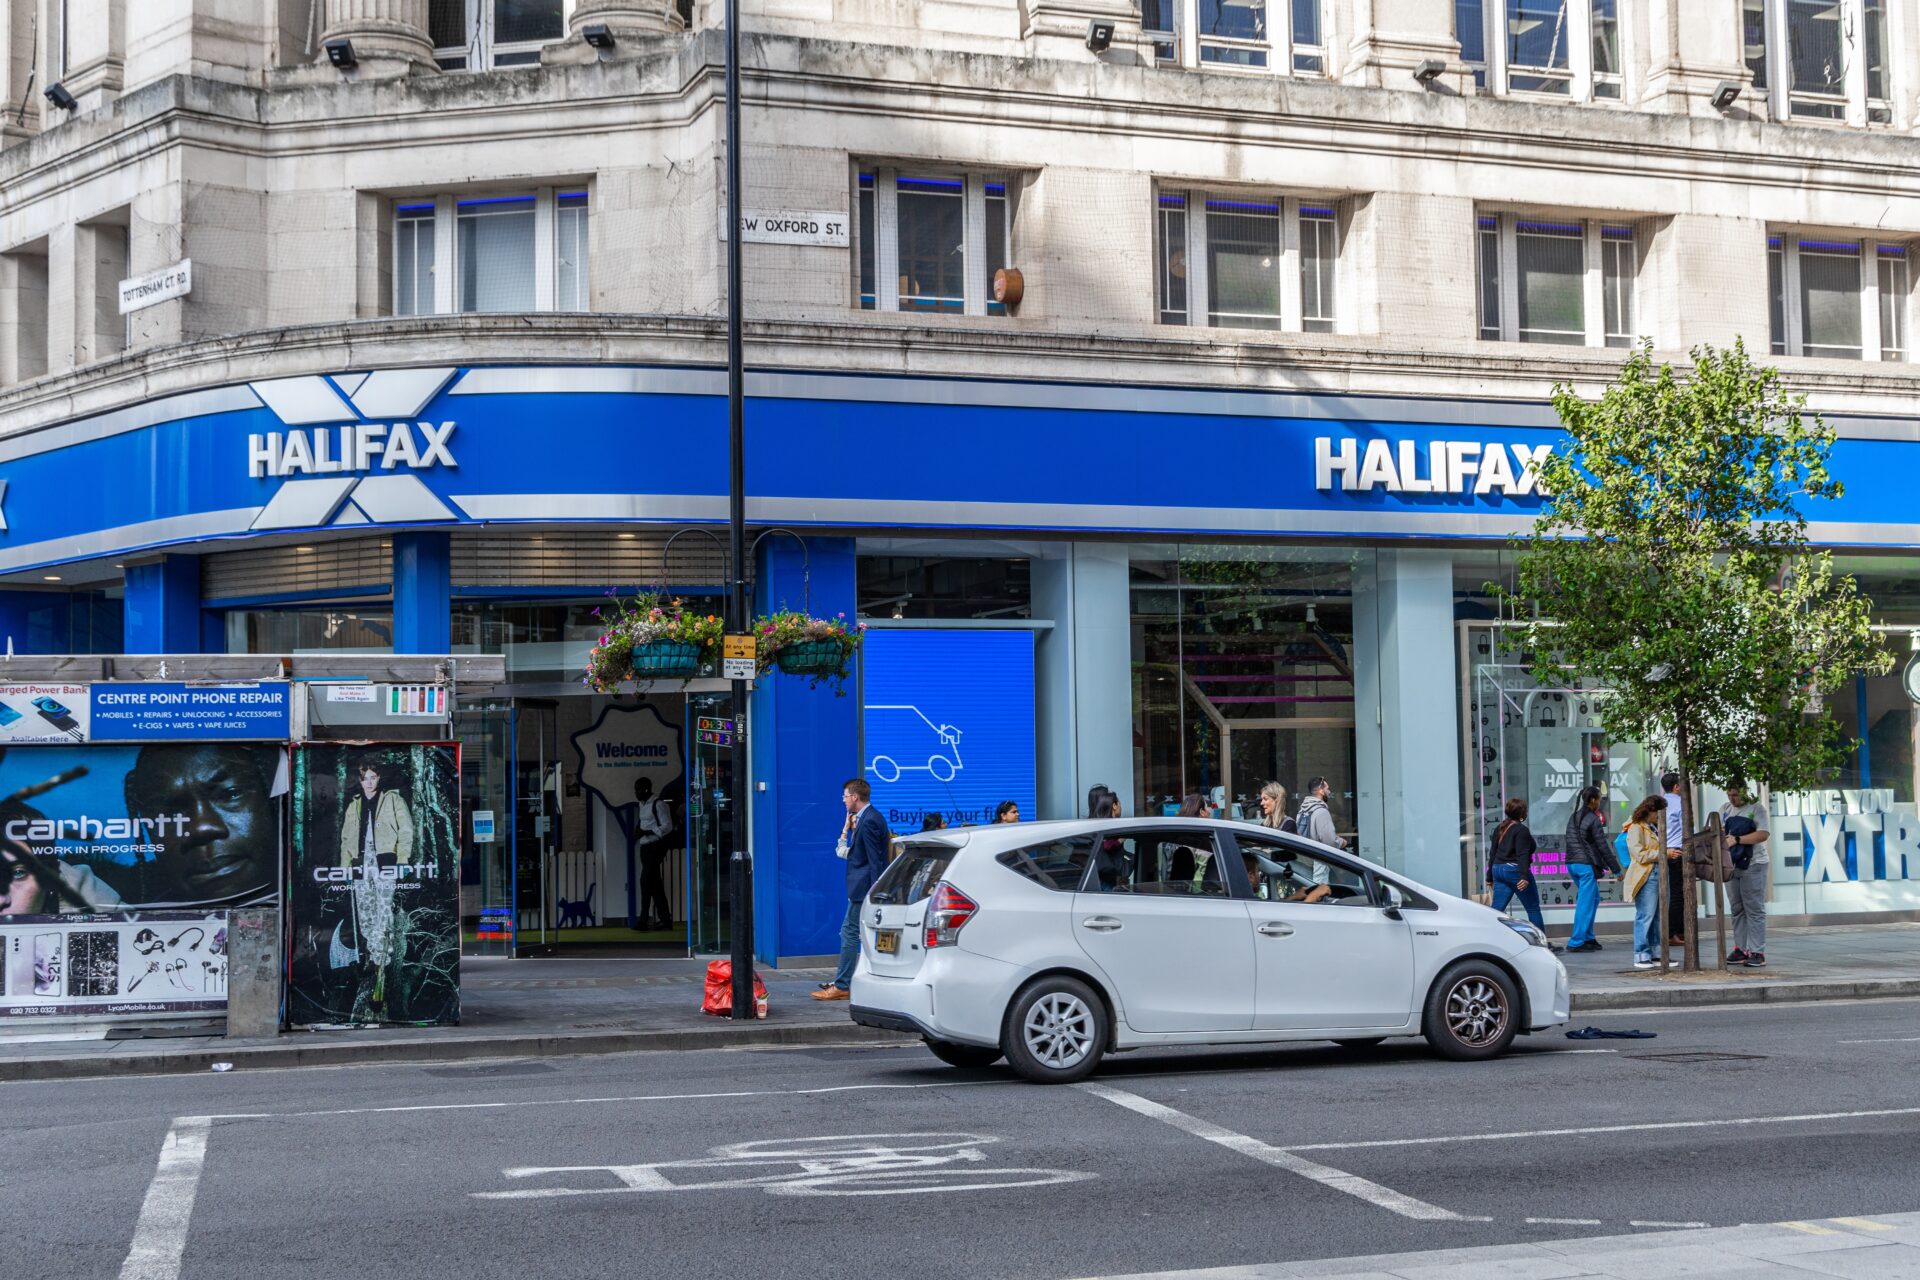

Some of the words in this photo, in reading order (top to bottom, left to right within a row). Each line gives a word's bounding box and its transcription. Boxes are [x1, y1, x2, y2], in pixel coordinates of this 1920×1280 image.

[765, 219, 819, 234] OXFORD
[825, 223, 844, 236] ST.
[123, 279, 164, 303] TOTTENHAM
[248, 420, 459, 478] HALIFAX
[1314, 437, 1554, 498] HALIFAX
[29, 685, 60, 695] Power
[63, 685, 88, 695] Bank
[97, 693, 147, 705] CENTRE
[150, 693, 189, 704] POINT
[192, 692, 236, 704] PHONE
[240, 692, 283, 704] REPAIR
[102, 711, 134, 719] MOBILES
[143, 711, 172, 719] REPAIRS
[235, 710, 283, 718] ACCESSORIES
[139, 722, 163, 730] E-CIGS
[595, 741, 669, 759] Welcome
[1842, 788, 1895, 815] YOU
[944, 809, 981, 825] your
[31, 845, 73, 855] WORK
[75, 846, 89, 854] IN
[91, 843, 166, 854] PROGRESS
[1538, 852, 1559, 863] YOUR
[1540, 864, 1558, 875] AND
[331, 884, 357, 892] WORK
[40, 1006, 57, 1014] 0322
[107, 1002, 166, 1012] LycaMobile.co.uk
